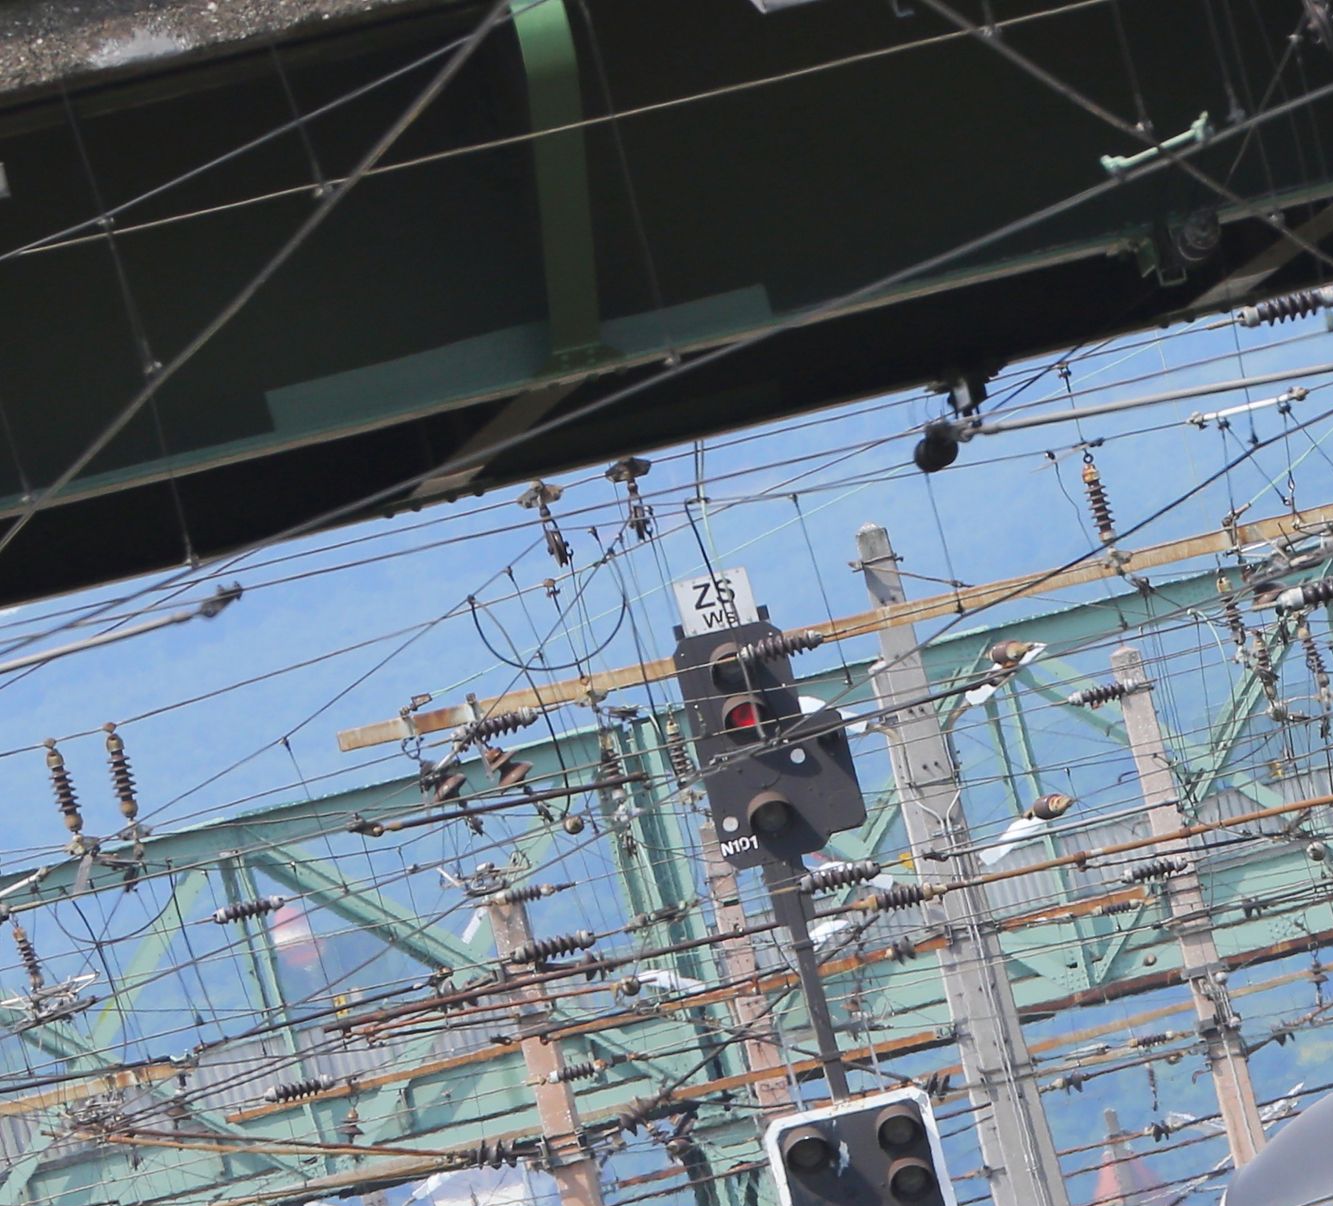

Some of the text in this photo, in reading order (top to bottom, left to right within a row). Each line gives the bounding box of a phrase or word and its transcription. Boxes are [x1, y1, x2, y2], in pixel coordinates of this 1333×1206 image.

[692, 578, 736, 611] ZS
[702, 609, 736, 629] Ws
[720, 834, 759, 858] N101
